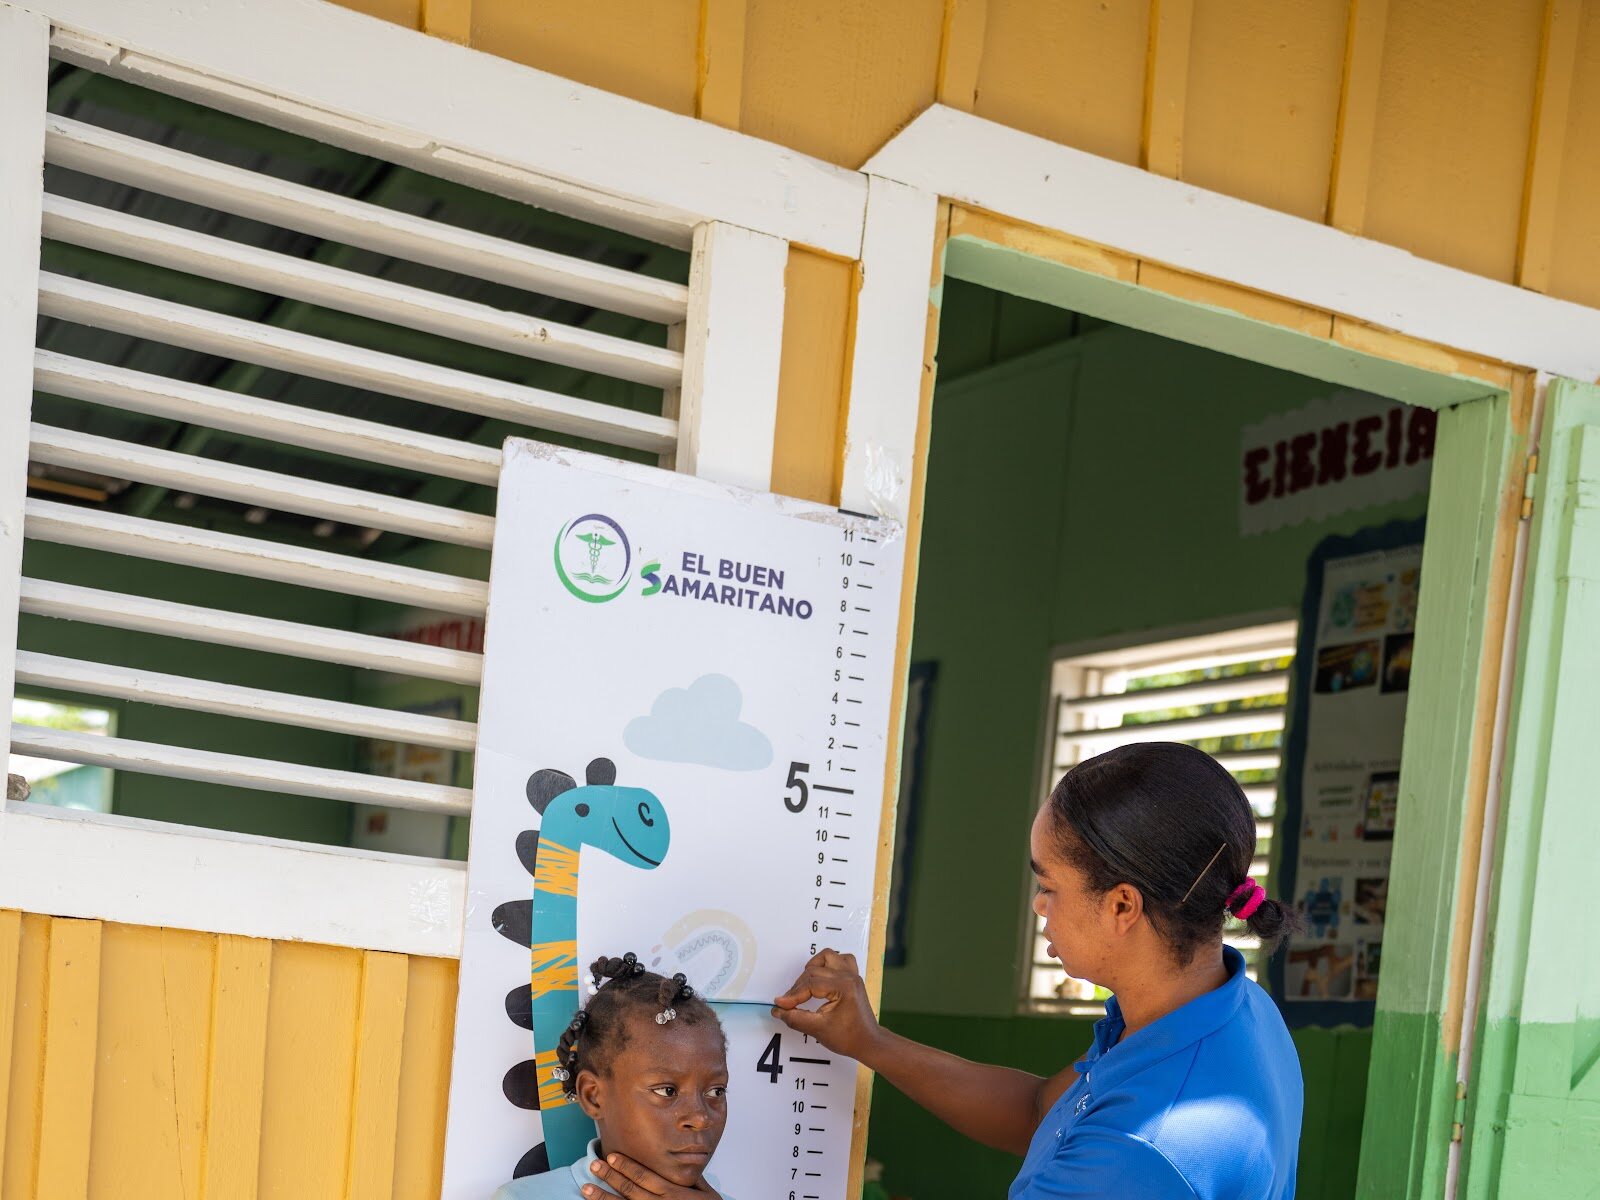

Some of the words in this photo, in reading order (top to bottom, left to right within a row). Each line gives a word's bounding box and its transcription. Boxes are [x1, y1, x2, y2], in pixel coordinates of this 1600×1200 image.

[843, 528, 854, 543] 11
[840, 552, 853, 567] 10
[681, 551, 711, 577] EL
[718, 558, 785, 591] BUEN
[842, 576, 849, 590] 9
[640, 563, 813, 620] SAMARITANO
[840, 599, 847, 613] 8
[838, 622, 845, 635] 7
[836, 646, 843, 659] 6
[834, 669, 841, 682] 5
[831, 692, 839, 705] 4
[830, 713, 837, 726] 3
[827, 737, 835, 750] 2
[783, 760, 810, 814] 5
[818, 806, 829, 819] 11
[815, 829, 828, 843] 10
[817, 852, 825, 865] 9
[815, 874, 823, 888] 8
[814, 897, 821, 910] 7
[811, 920, 819, 933] 6
[809, 943, 817, 955] 5
[756, 1032, 784, 1084] 4
[794, 1077, 806, 1091] 11
[792, 1100, 805, 1114] 10
[794, 1123, 801, 1136] 9
[792, 1145, 799, 1158] 8
[791, 1167, 798, 1181] 7
